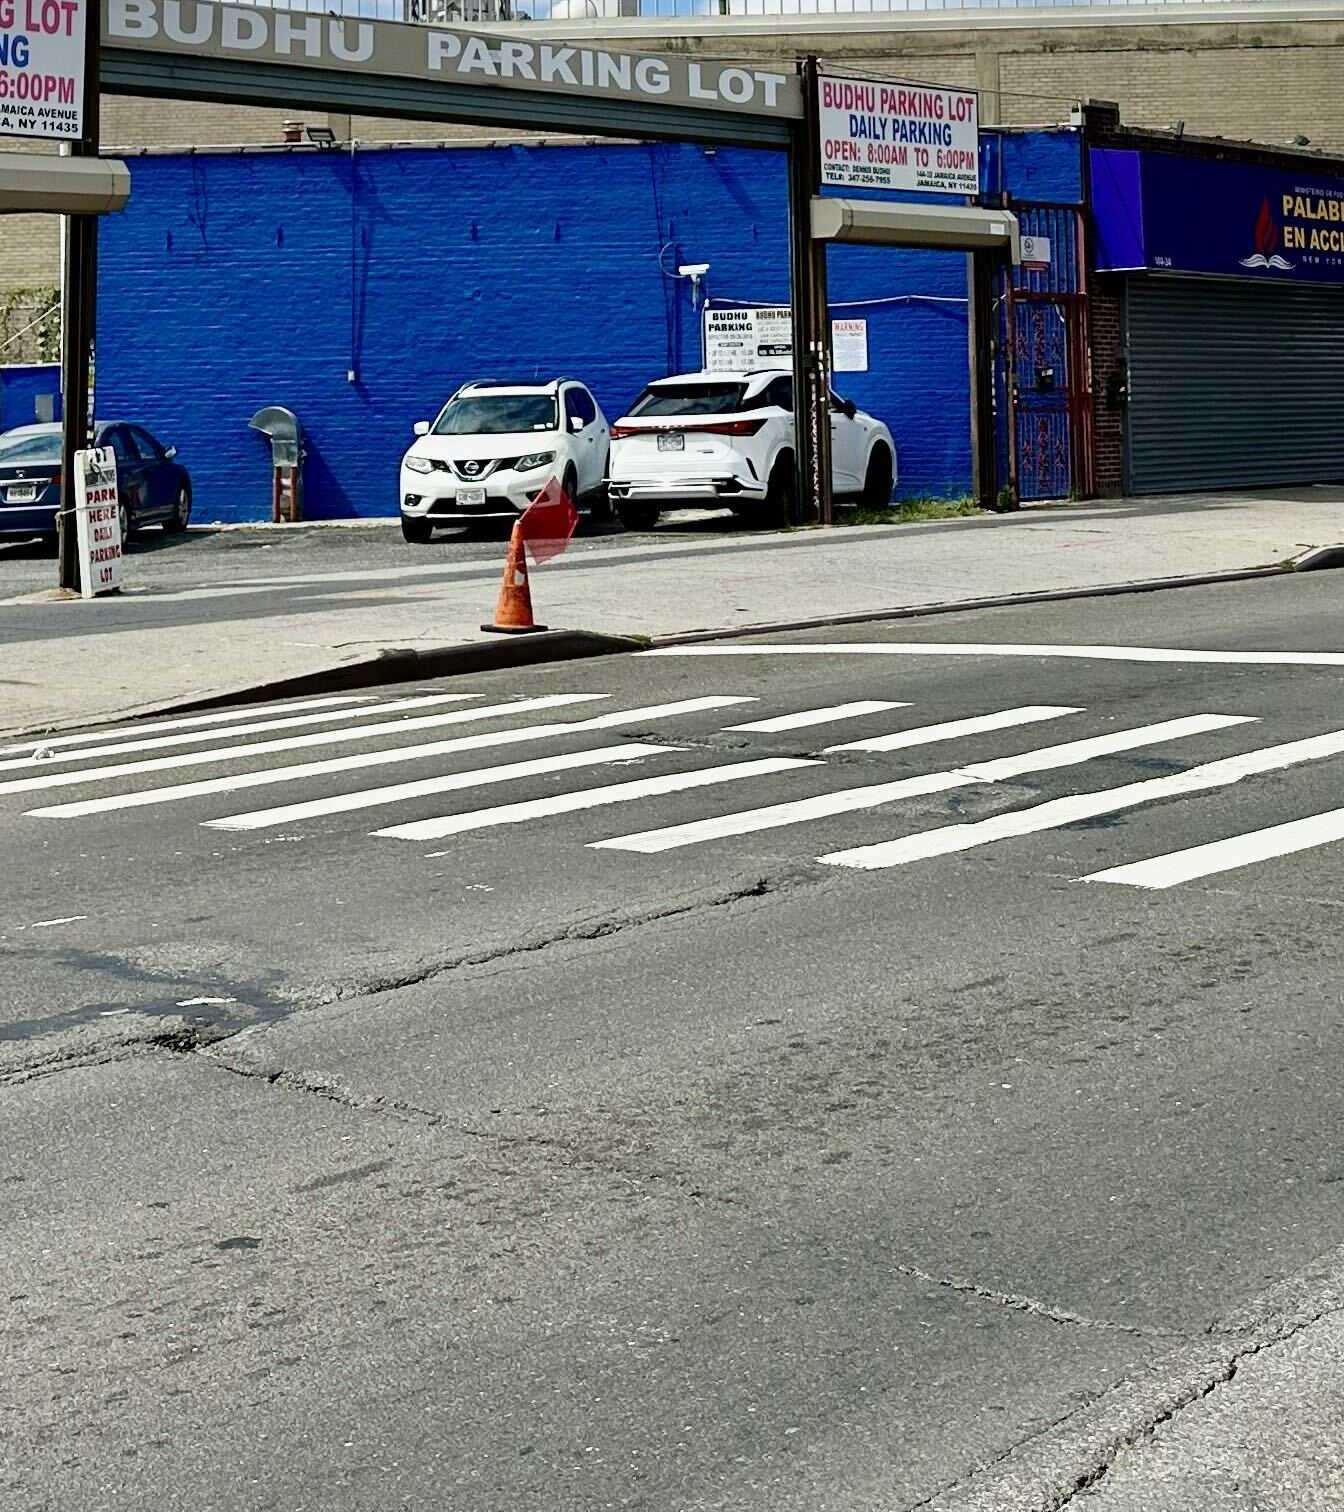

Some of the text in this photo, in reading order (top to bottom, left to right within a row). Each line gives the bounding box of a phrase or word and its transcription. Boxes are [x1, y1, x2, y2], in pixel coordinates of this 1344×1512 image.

[427, 31, 671, 95] PARKING
[688, 64, 788, 108] LOT
[823, 81, 974, 122] BUDHU PARKING LOT
[38, 108, 78, 120] AVENUE
[18, 118, 37, 130] NY
[41, 121, 79, 133] 11435
[849, 113, 952, 147] DAILY PARKING
[825, 139, 974, 171] OPEN: 8:00AM TO 6:00PM
[1283, 226, 1305, 249] EN
[712, 311, 748, 321] BUDHU
[708, 323, 753, 332] PARKING
[86, 487, 116, 505] PARK
[88, 506, 117, 523] HERE
[94, 527, 113, 542] DAILY
[90, 544, 121, 564] PARKING
[100, 567, 113, 583] LOT
